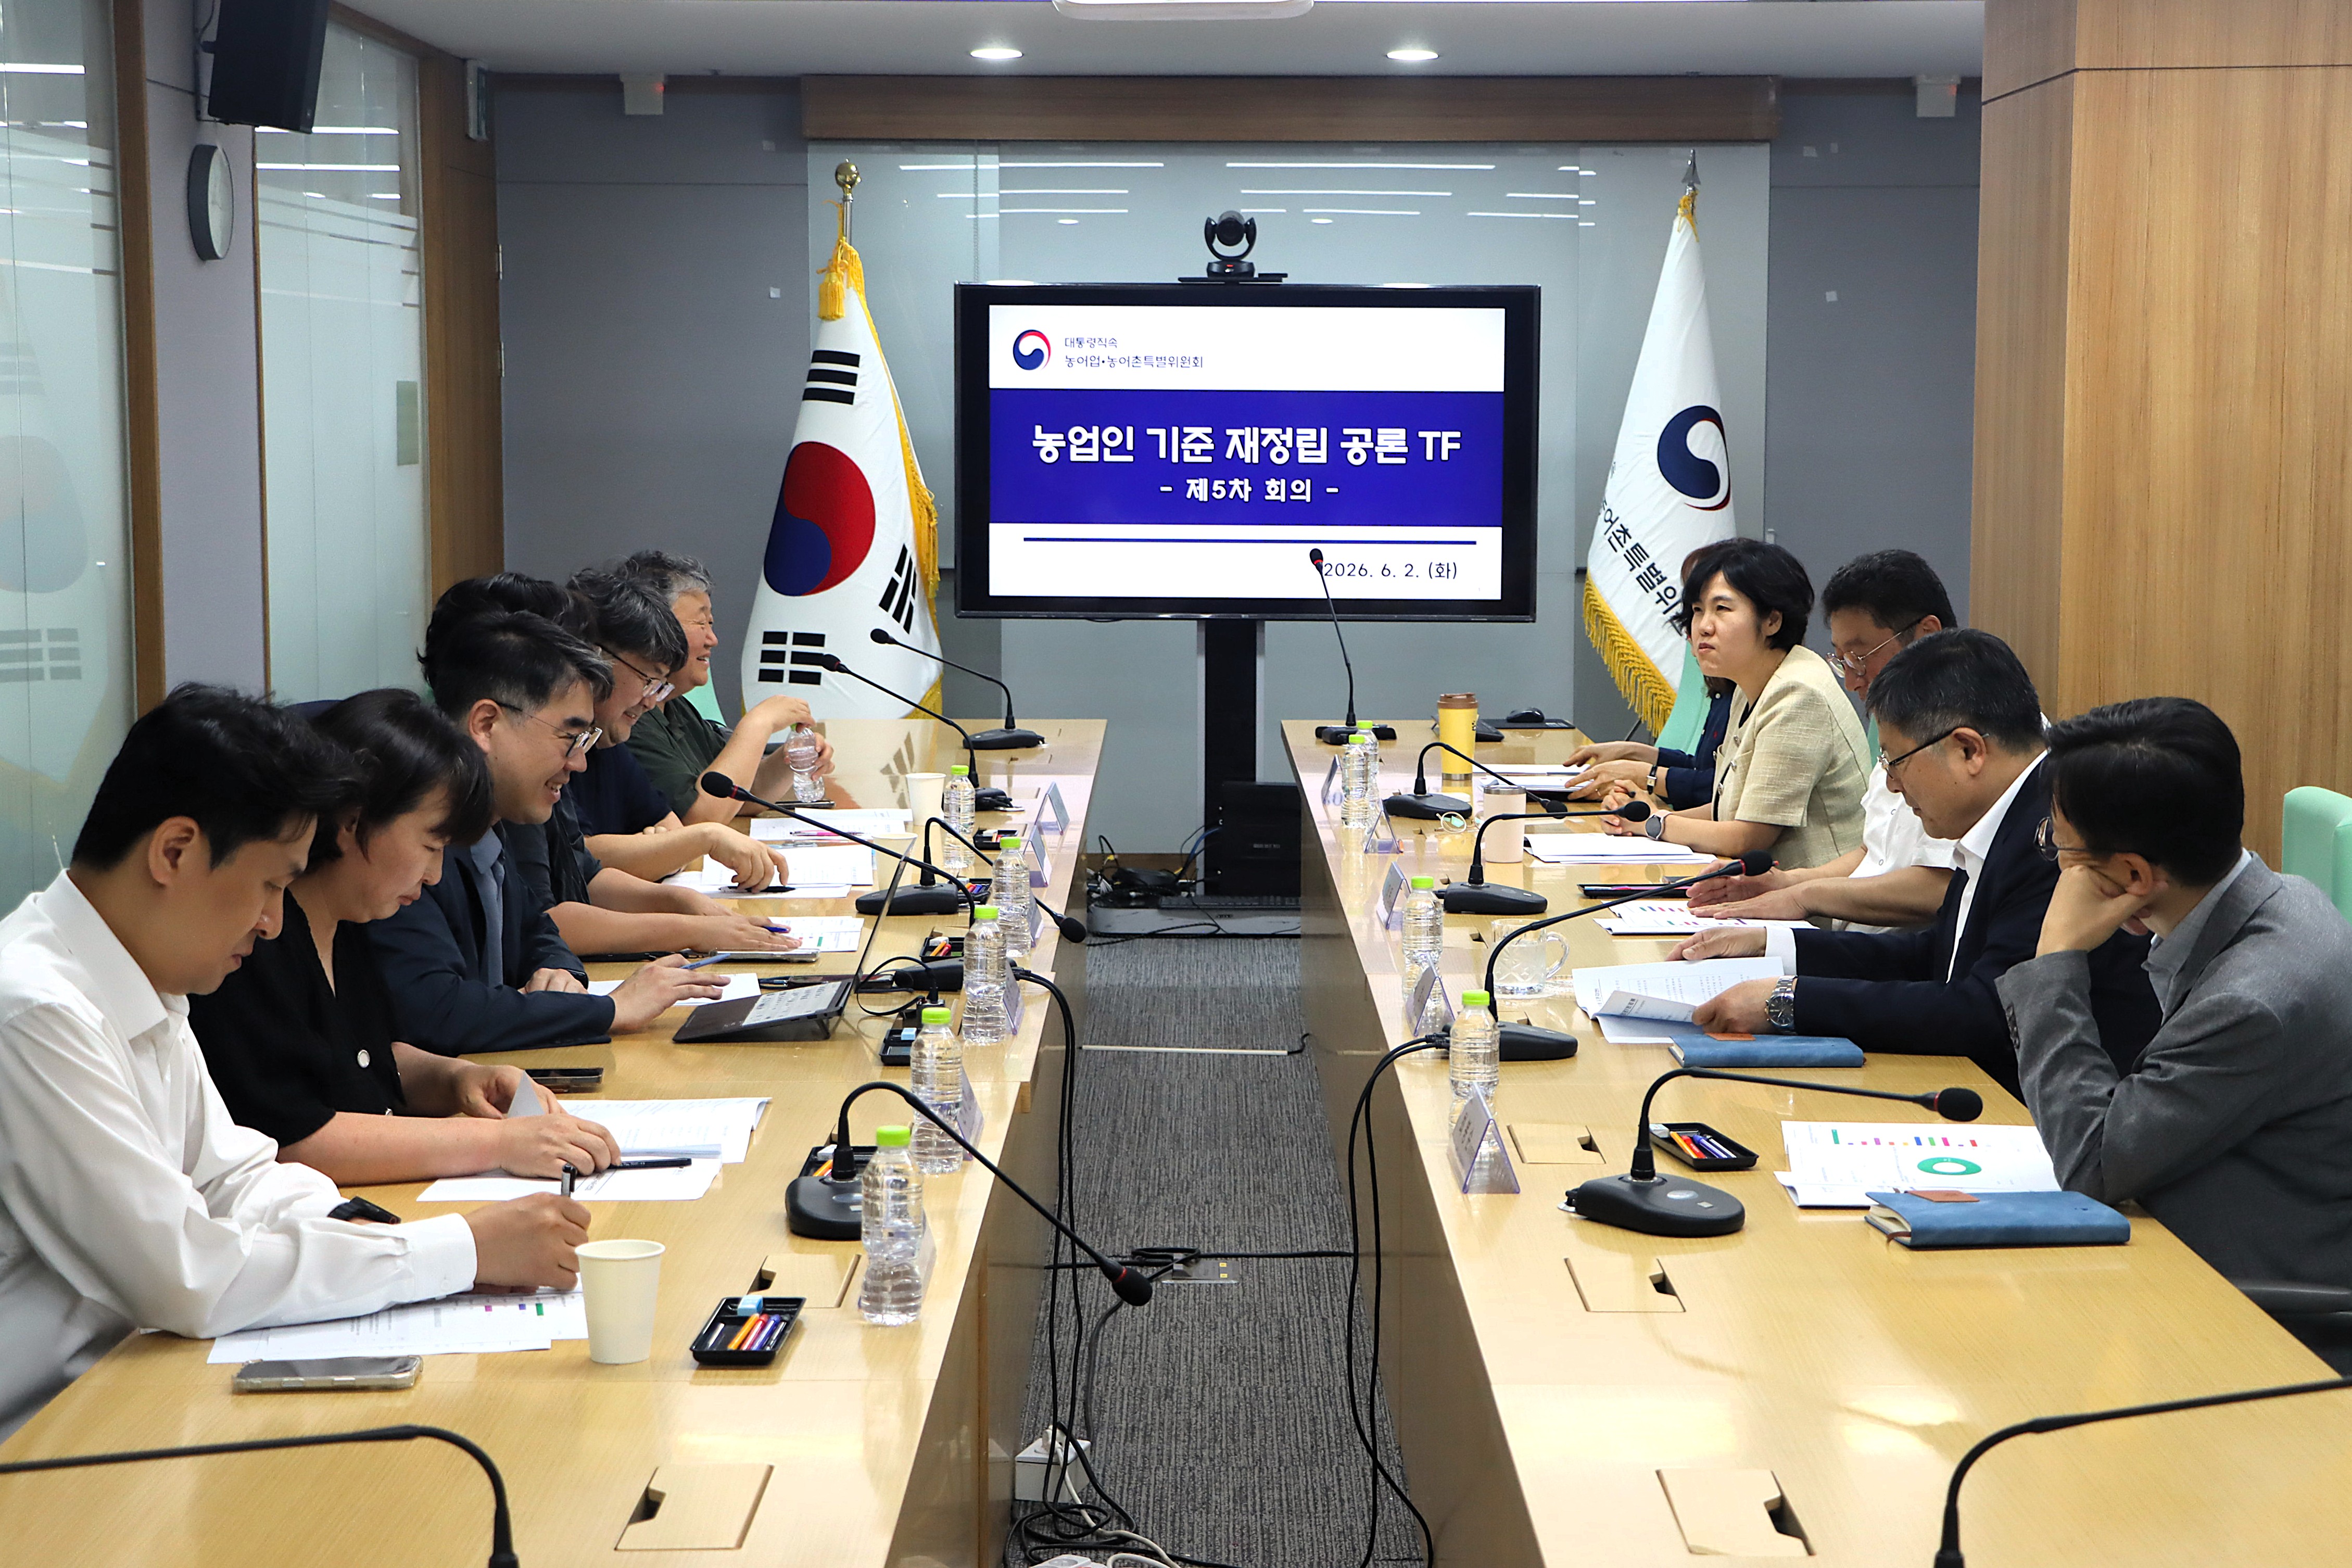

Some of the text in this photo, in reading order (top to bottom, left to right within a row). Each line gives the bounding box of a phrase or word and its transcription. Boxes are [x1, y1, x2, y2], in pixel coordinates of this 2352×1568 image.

[1065, 337, 1117, 348] 대통령직속
[1032, 425, 1461, 465] 농업인 기준 재정립 공론 TF
[1186, 478, 1252, 502] 제5차
[1264, 478, 1311, 502] 회의
[1324, 562, 1457, 579] 2026. 6. 2. (화)
[1602, 497, 1683, 637] 어촌특별위
